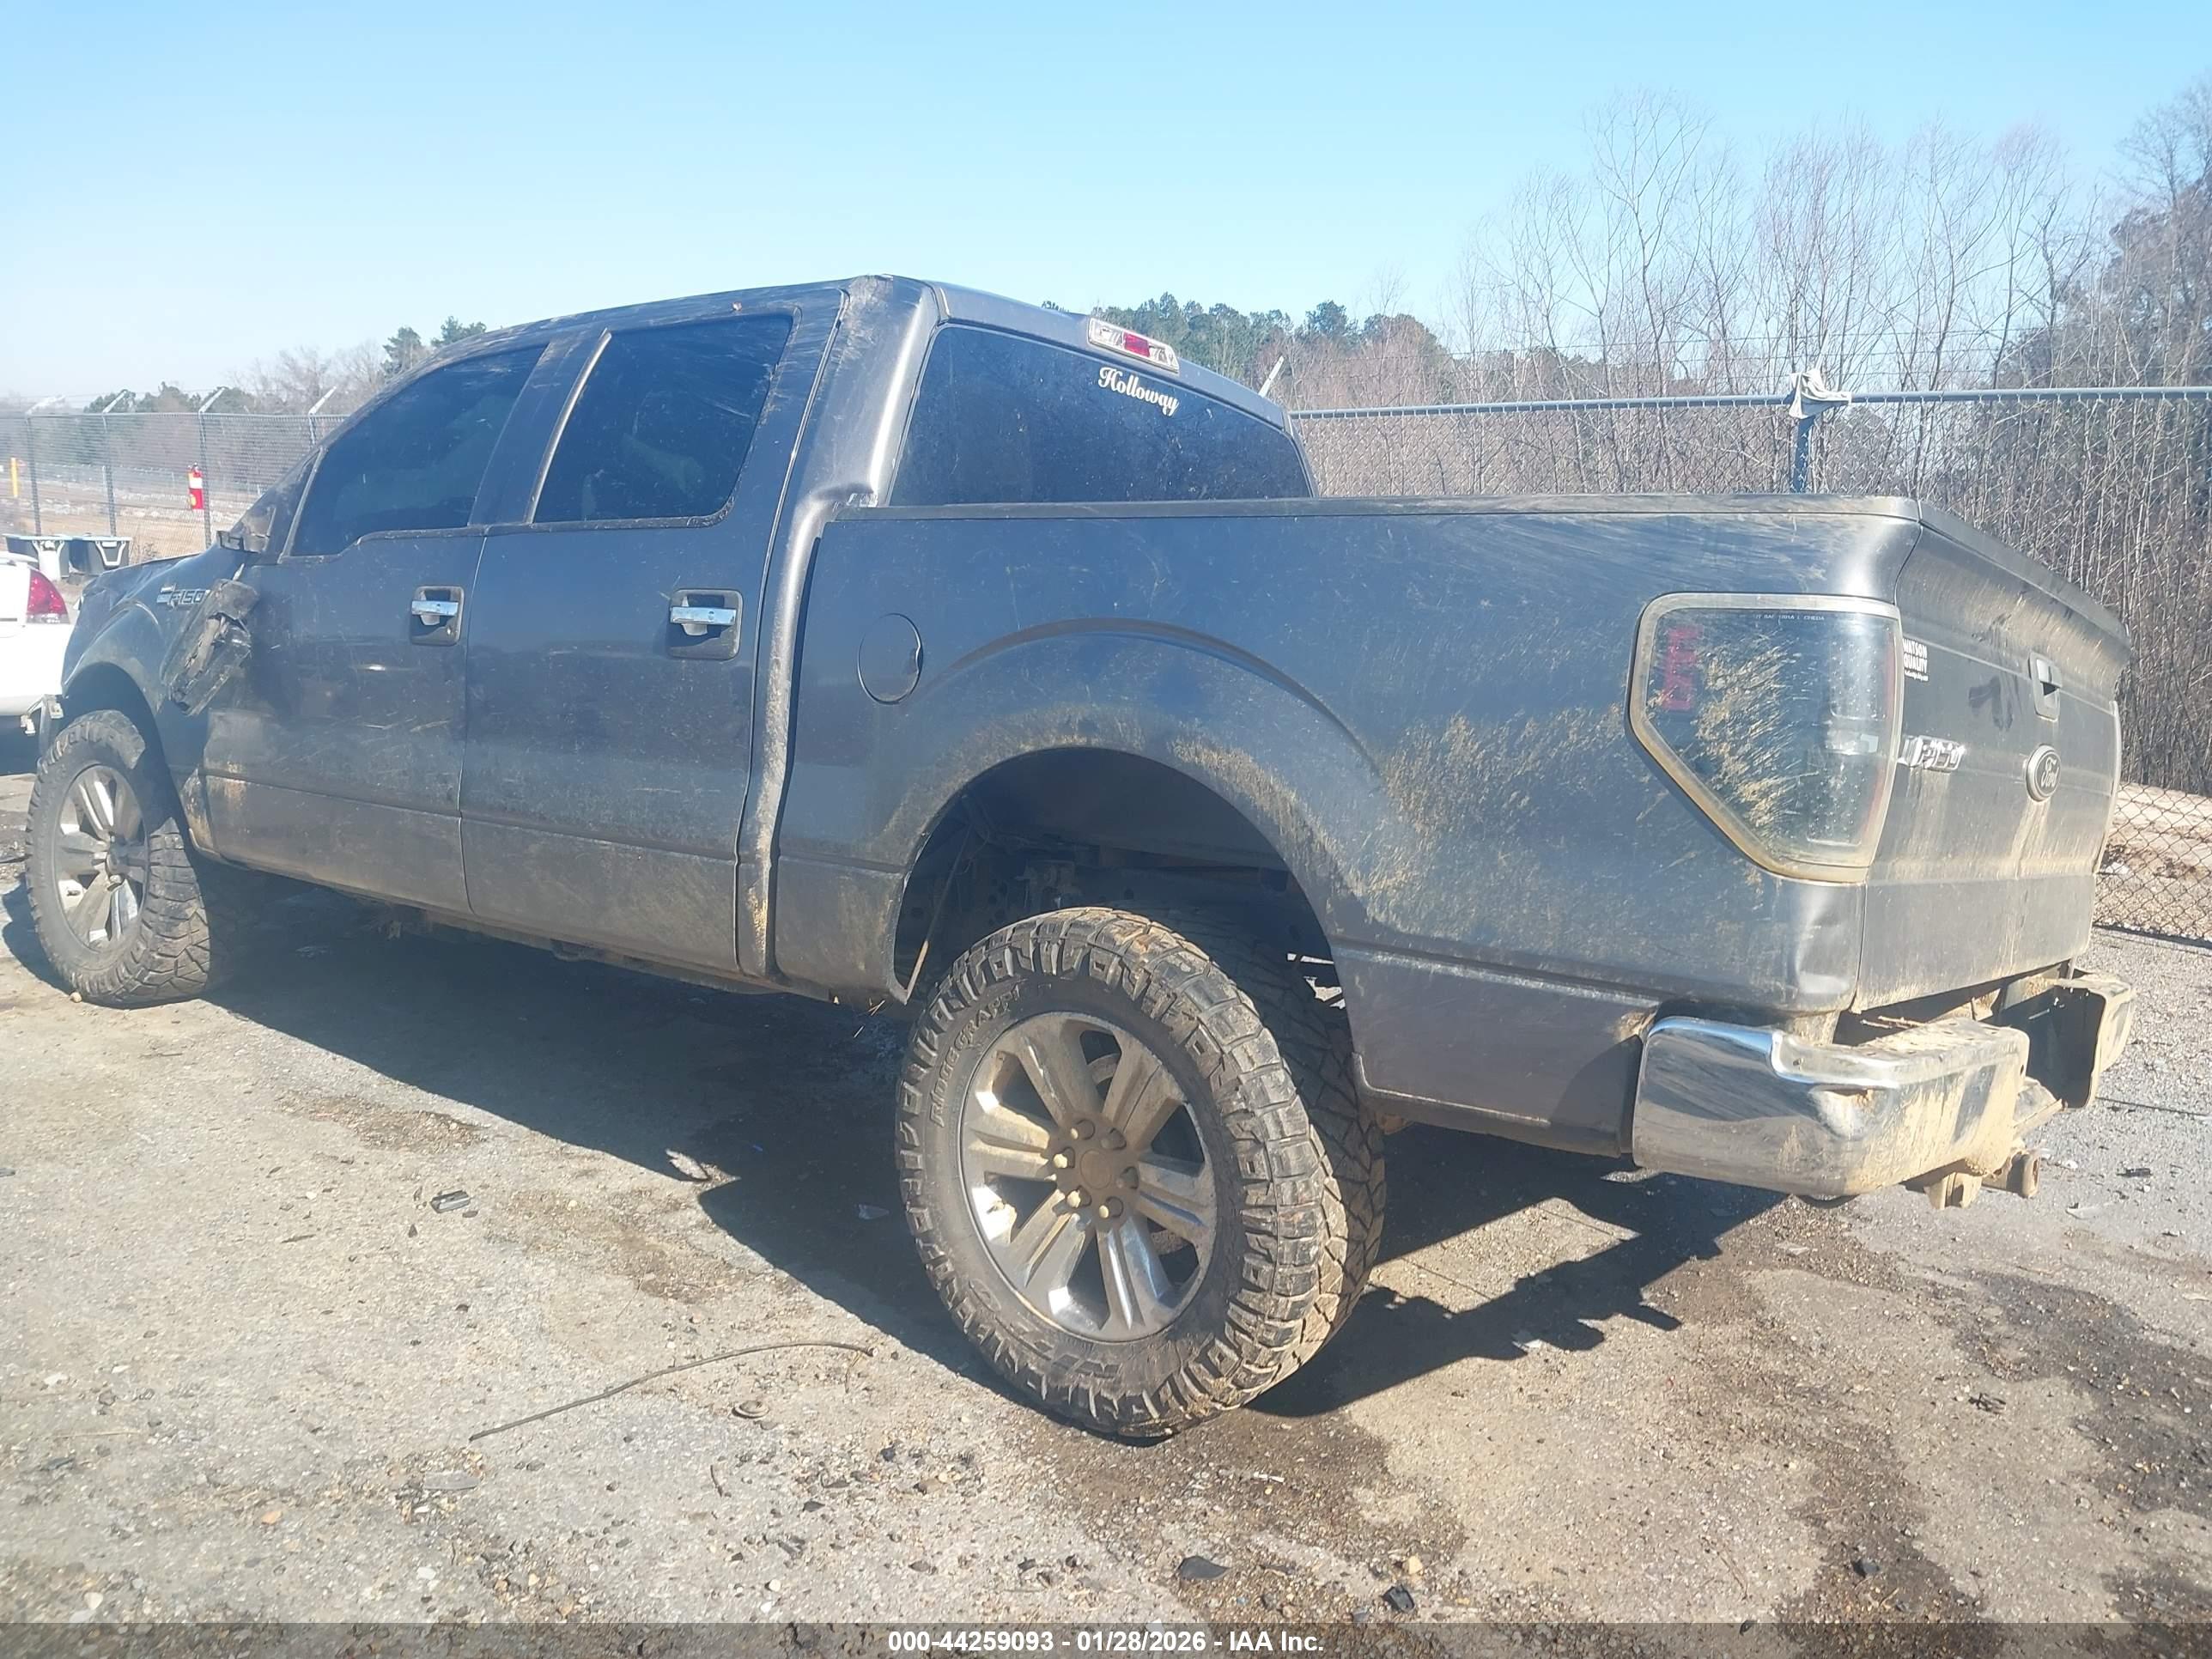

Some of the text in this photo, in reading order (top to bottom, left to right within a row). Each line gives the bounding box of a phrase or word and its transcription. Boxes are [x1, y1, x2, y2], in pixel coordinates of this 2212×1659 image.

[1098, 367, 1180, 417] Holloway
[1902, 638, 1928, 659] WATSON
[1903, 653, 1928, 673] QUALITY
[2041, 756, 2060, 787] Ford
